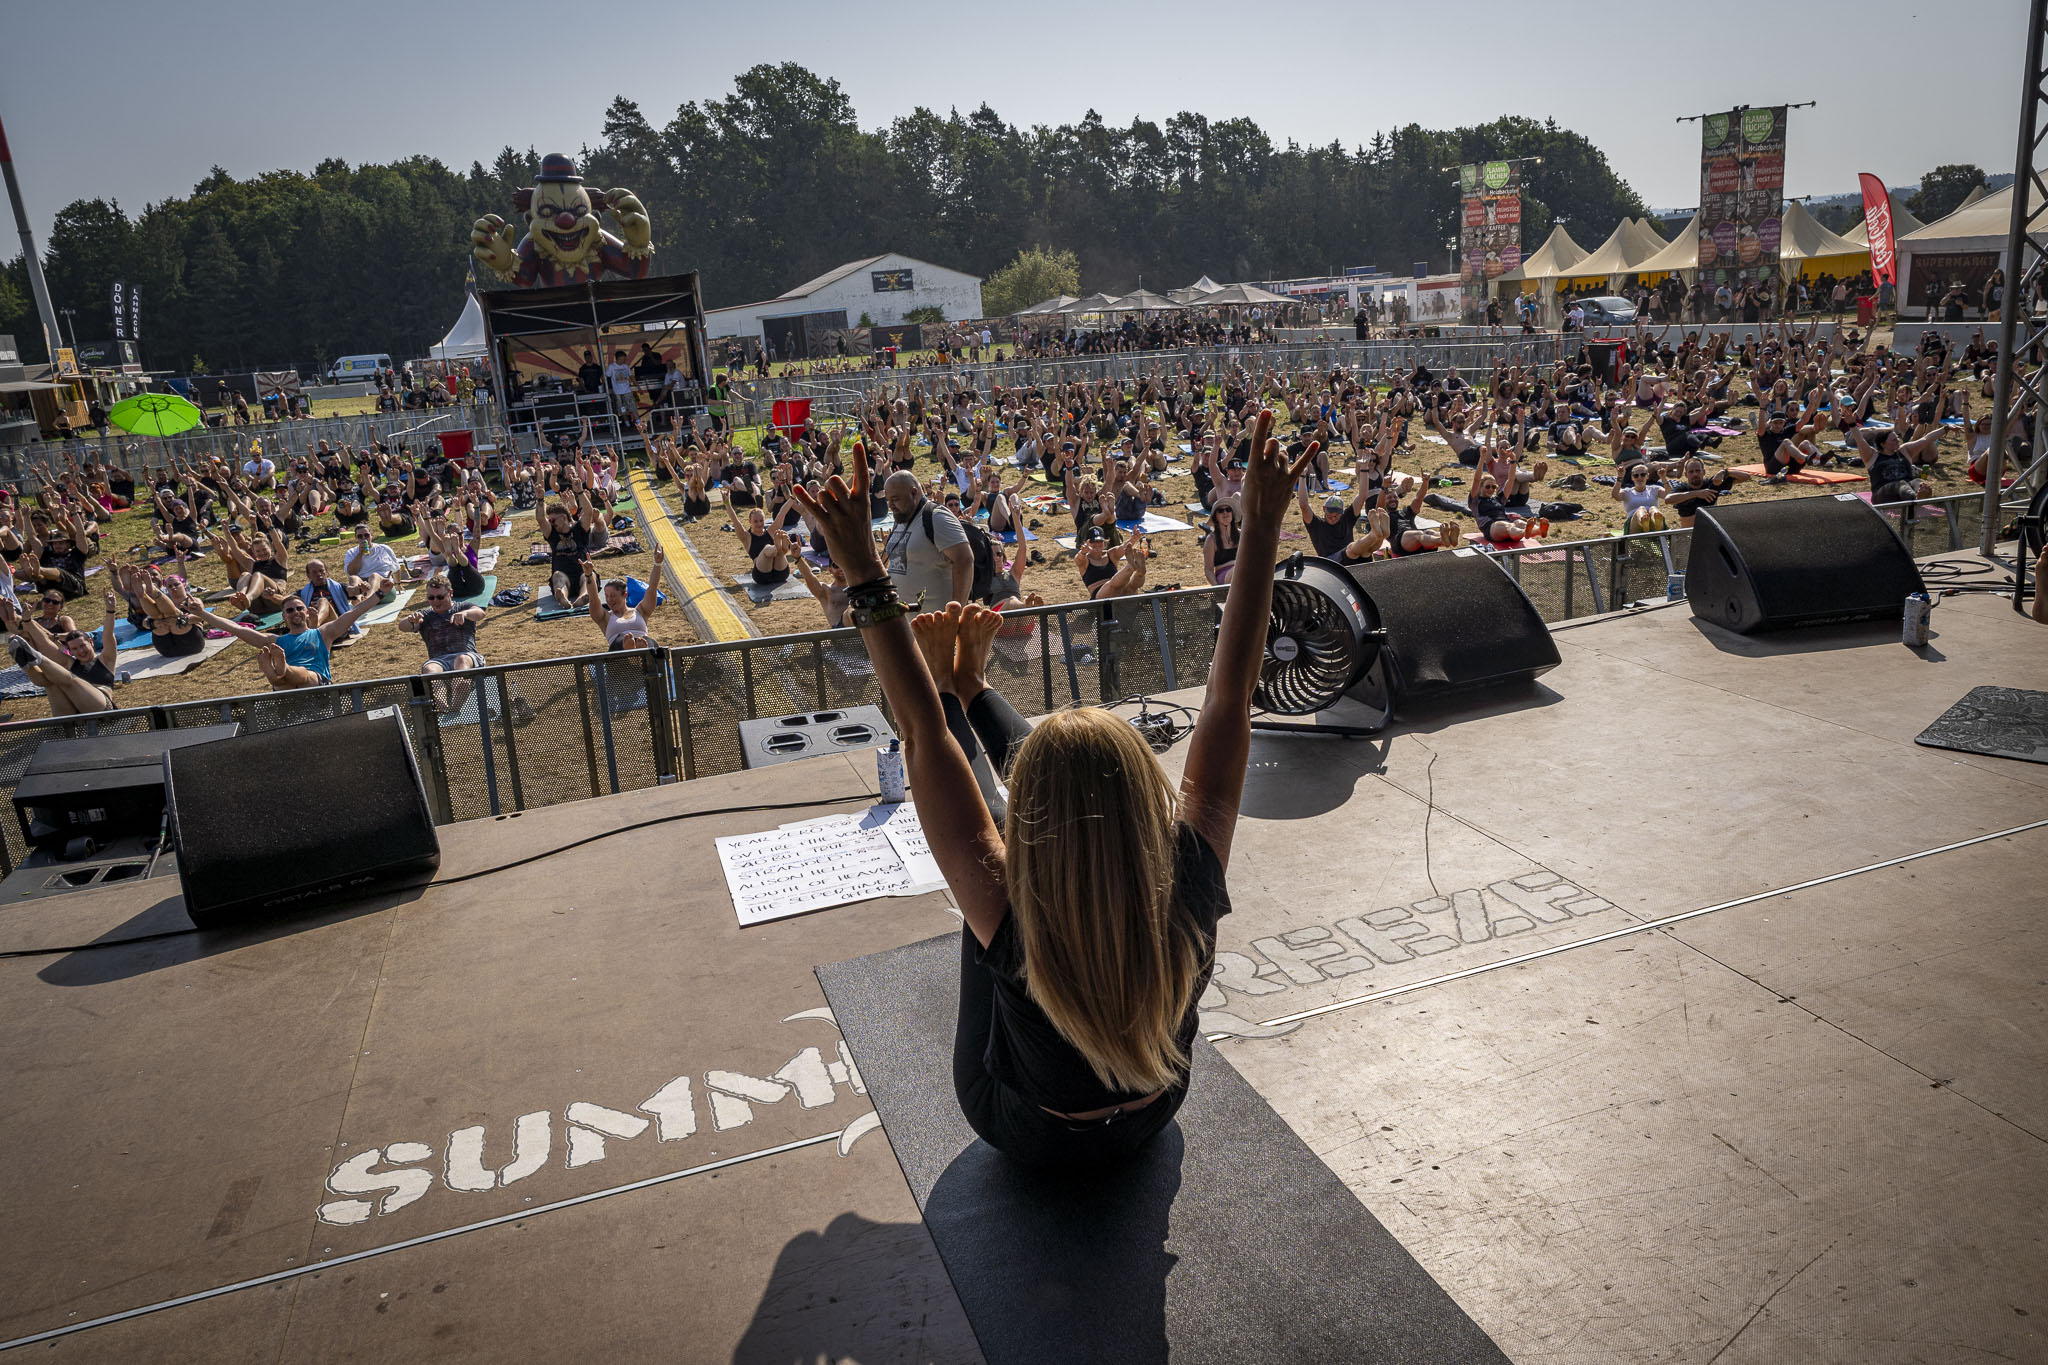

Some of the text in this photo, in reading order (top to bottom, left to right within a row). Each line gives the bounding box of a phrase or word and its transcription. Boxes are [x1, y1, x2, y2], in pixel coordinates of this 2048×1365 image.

[1745, 115, 1771, 124] FLAMM-
[1745, 123, 1771, 132] KUCHEN
[1486, 166, 1507, 174] FLAMM-
[1746, 190, 1767, 198] KAFFEE
[1915, 255, 1996, 267] SUPERMARKT
[114, 283, 124, 337] DÖNER
[132, 288, 140, 339] LAHMACUN
[728, 827, 823, 848] YEAR ZERO
[729, 851, 752, 860] OV
[799, 837, 826, 845] THE
[732, 858, 767, 869] SAD
[737, 854, 844, 880] STRANDED
[738, 872, 803, 890] ALISON
[810, 863, 849, 874] HELL
[741, 862, 901, 902] SOUTH OF HEAVEN
[839, 879, 911, 899] OFFERING
[749, 902, 779, 913] THE
[1198, 870, 1615, 1009] REEZE
[315, 1038, 868, 1227] SUMM
